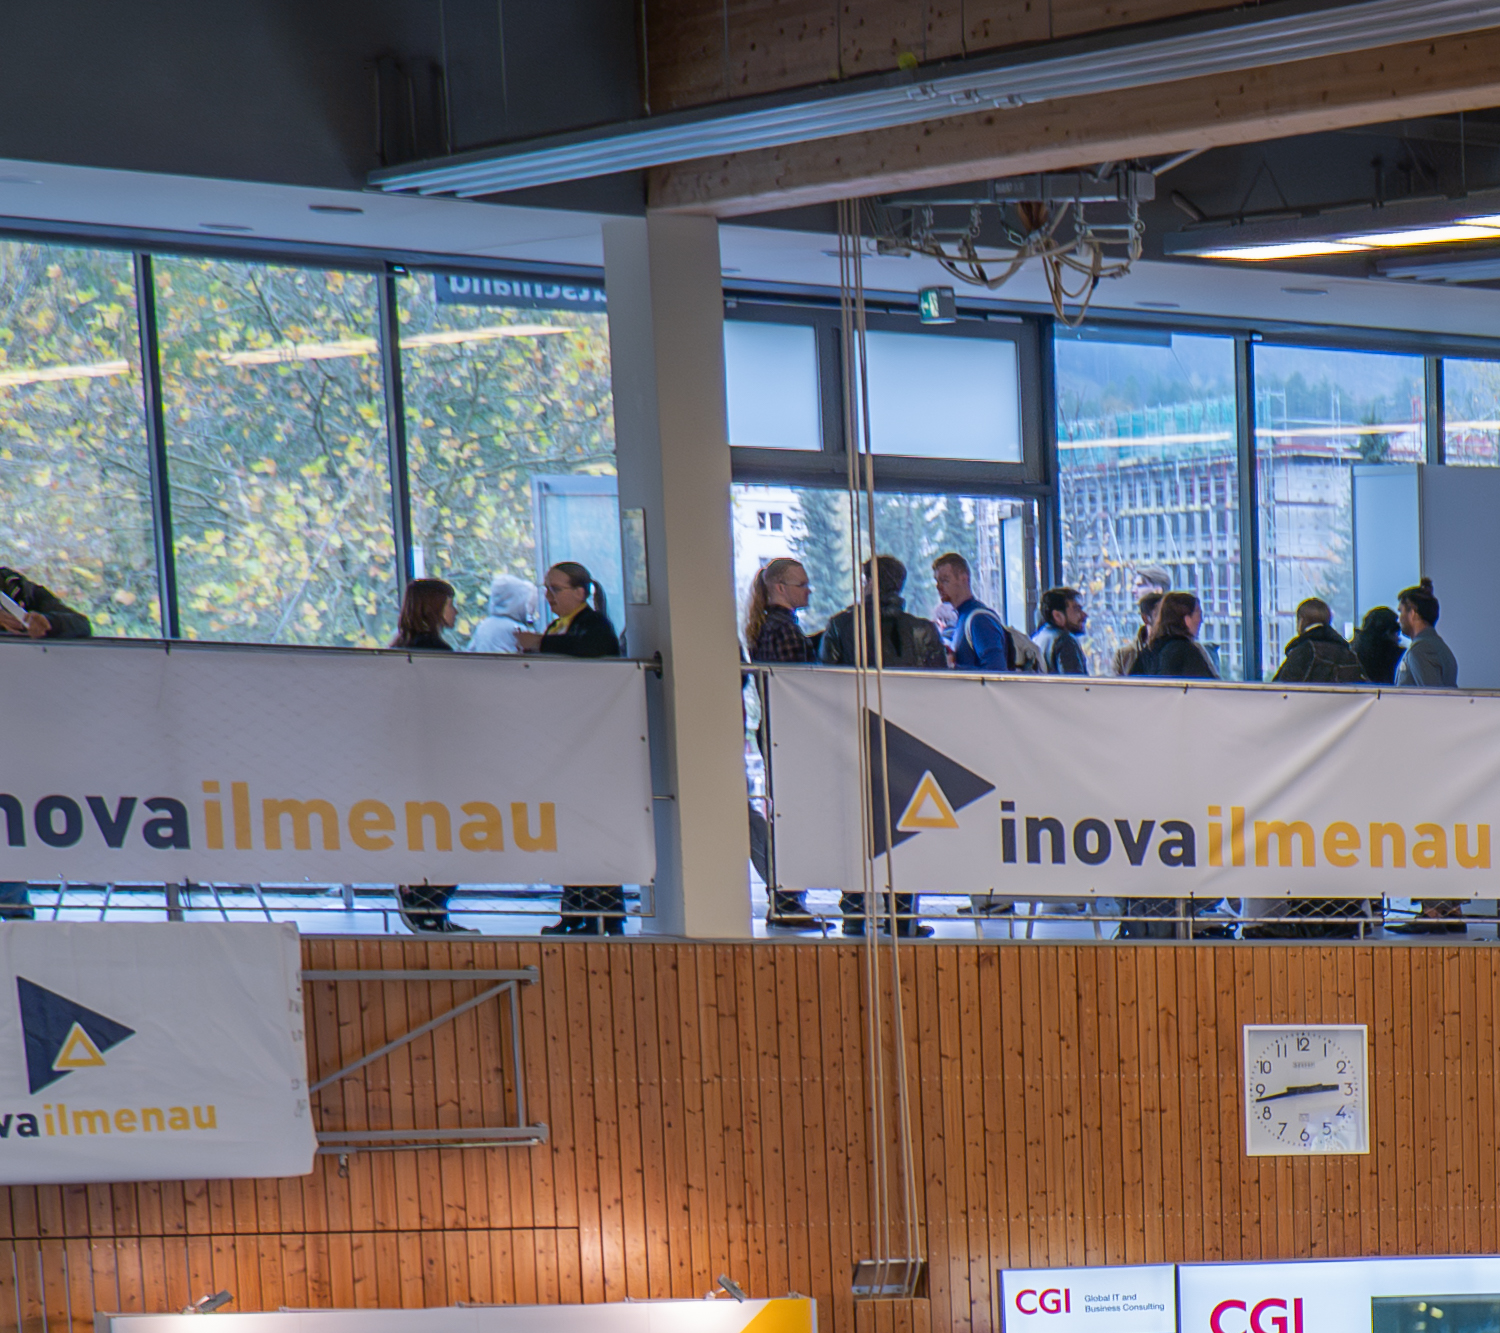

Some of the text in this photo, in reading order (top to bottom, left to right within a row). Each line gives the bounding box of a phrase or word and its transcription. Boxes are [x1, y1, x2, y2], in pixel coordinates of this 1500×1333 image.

[0, 781, 558, 853] novailmenau
[1001, 801, 1492, 870] inovailmenau
[0, 1104, 217, 1138] vailmenau
[1015, 1288, 1071, 1315] CGI
[1085, 1302, 1165, 1312] Business Consulting
